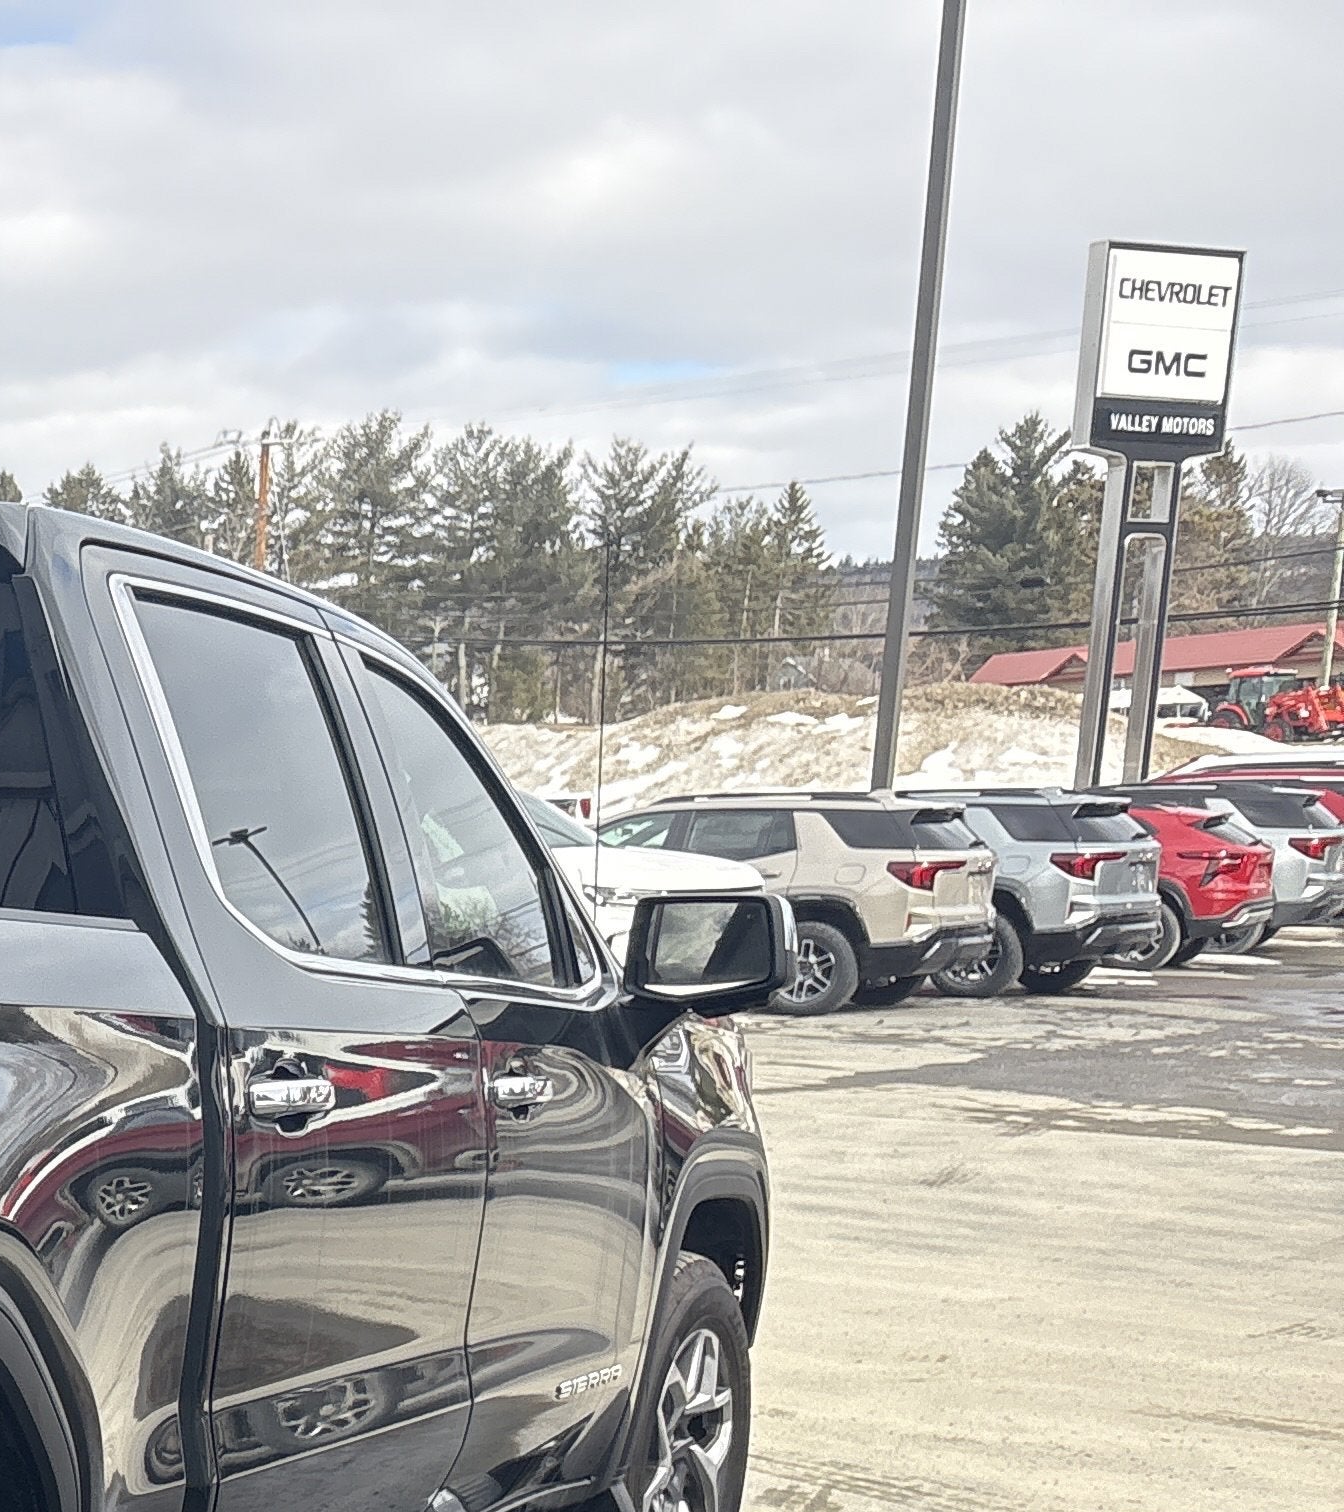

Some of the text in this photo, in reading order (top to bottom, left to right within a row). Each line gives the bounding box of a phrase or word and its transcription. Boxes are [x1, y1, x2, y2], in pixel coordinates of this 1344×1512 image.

[1118, 277, 1232, 308] CHEVROLET
[1127, 348, 1208, 378] GMC
[1110, 412, 1215, 436] VALLEY MOTORS
[554, 1363, 623, 1400] SIERRA
